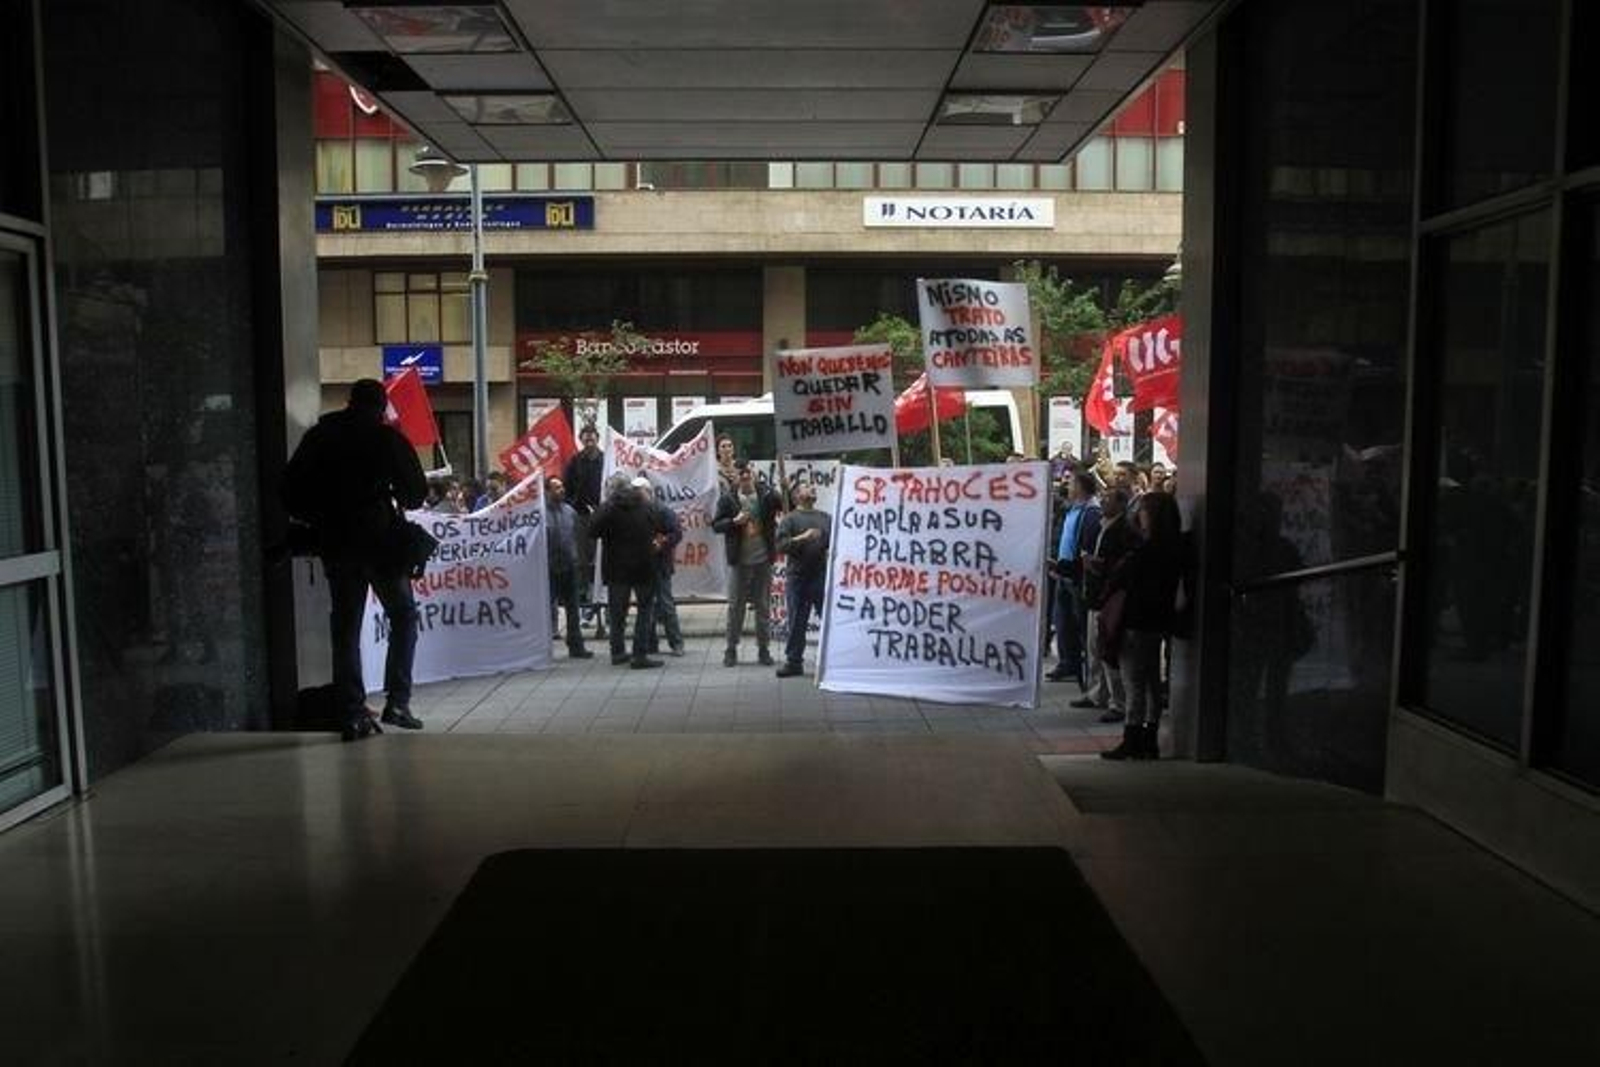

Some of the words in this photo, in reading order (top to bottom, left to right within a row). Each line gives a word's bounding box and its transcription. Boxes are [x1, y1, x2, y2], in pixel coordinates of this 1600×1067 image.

[906, 201, 1034, 220] NOTARÍA
[942, 306, 1005, 326] TRATO
[778, 356, 813, 377] NON
[931, 345, 1034, 369] CANTEIRAS
[793, 373, 881, 395] QUEDAR
[807, 395, 852, 413] SIN
[781, 412, 888, 440] TRABALLO
[653, 484, 697, 501] ALLO
[890, 471, 1038, 504] TAHOCES
[841, 505, 921, 536] CUMPLA
[926, 511, 940, 530] A
[944, 507, 1003, 532] SUA
[427, 533, 527, 565] PERIENCIA
[864, 534, 998, 574] PALABRA
[411, 563, 510, 597] QUEIRAS
[839, 561, 929, 596] INFORME
[936, 569, 1038, 607] POSITIVO
[860, 596, 876, 621] A
[881, 595, 966, 633] PODER
[867, 629, 1027, 682] TRABALLAR
